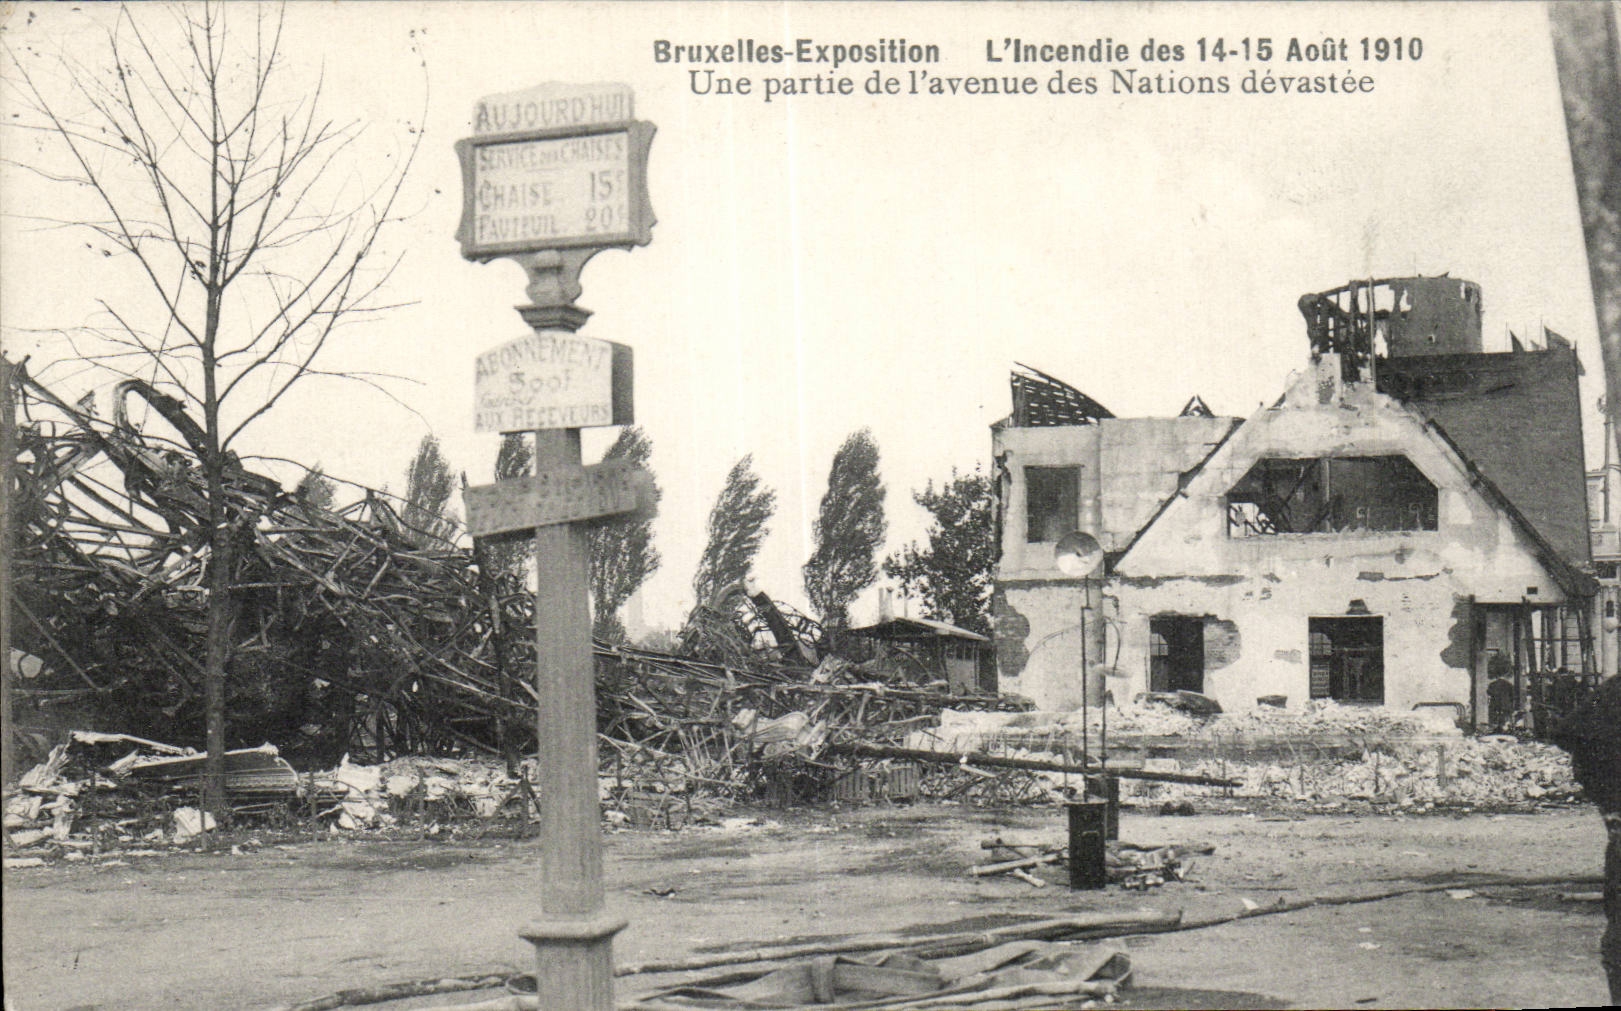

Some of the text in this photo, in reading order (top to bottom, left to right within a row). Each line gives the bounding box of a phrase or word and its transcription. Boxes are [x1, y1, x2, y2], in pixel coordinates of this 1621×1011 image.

[479, 145, 537, 171] SERVICE
[560, 137, 624, 162] CHAISES
[478, 180, 553, 210] CHAISE
[478, 214, 561, 240] FAUTEUIL
